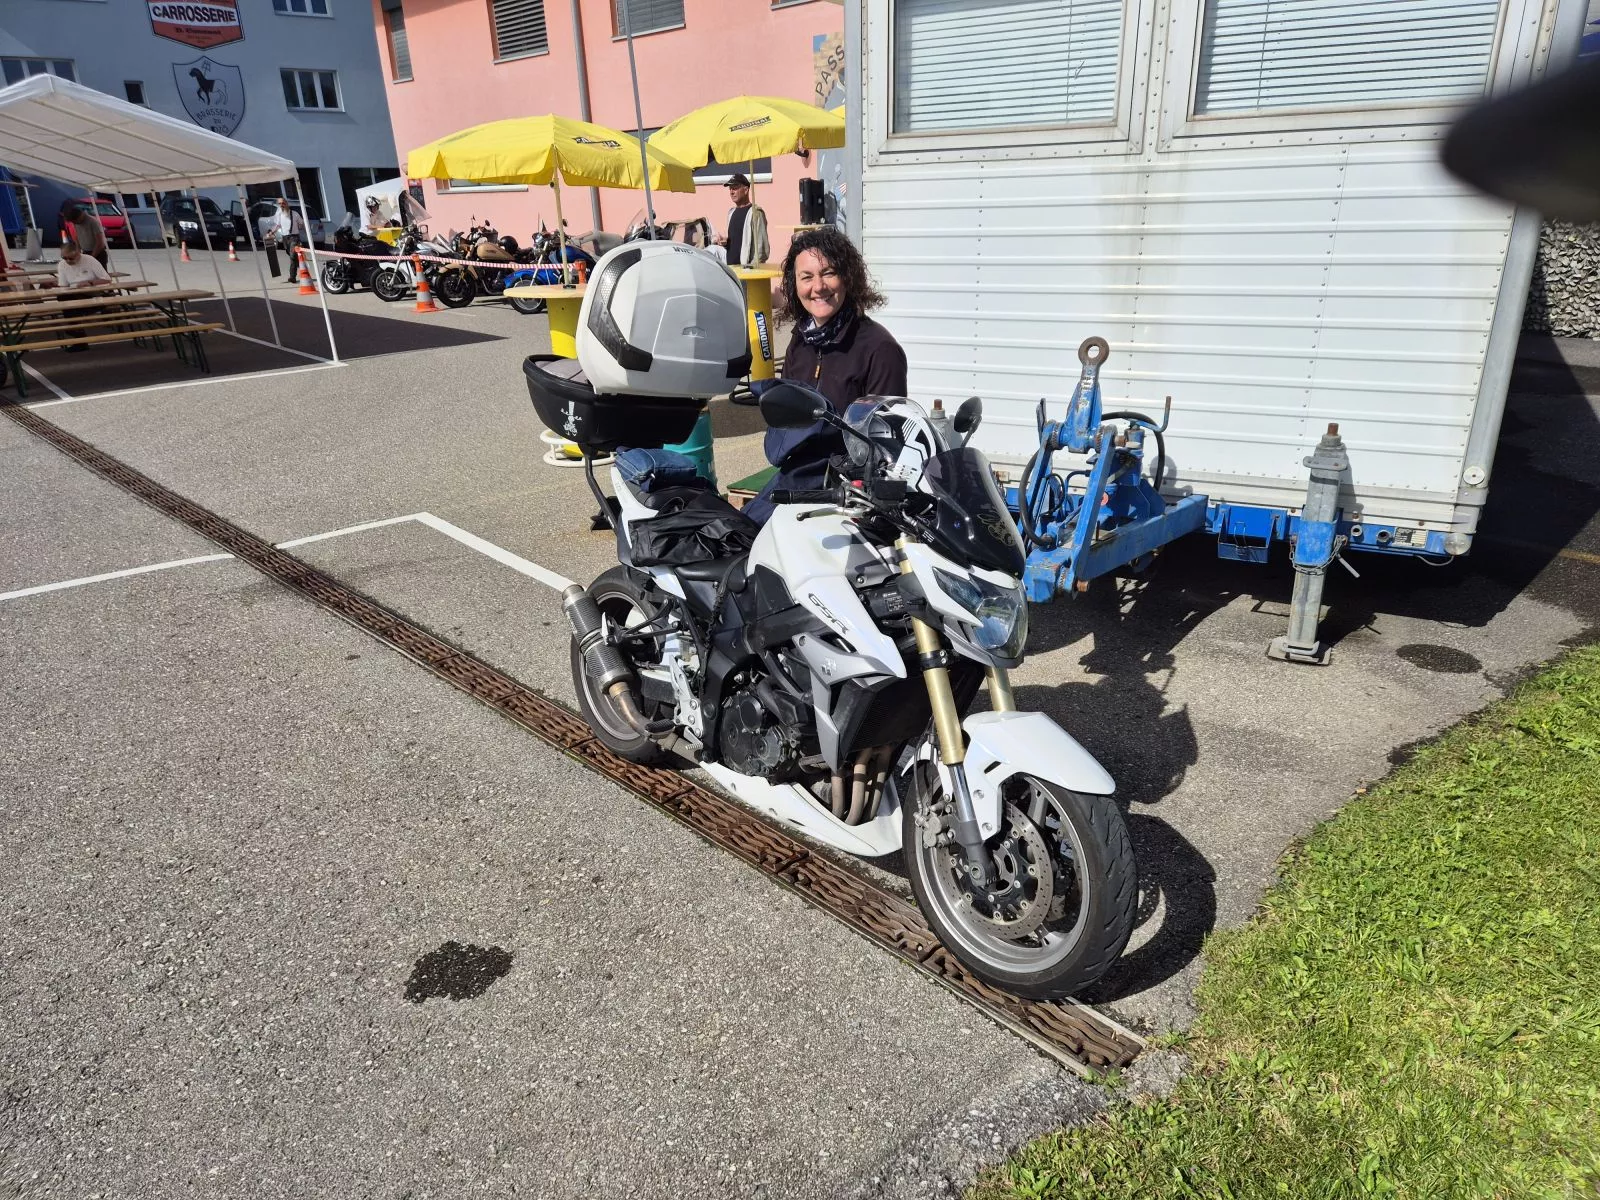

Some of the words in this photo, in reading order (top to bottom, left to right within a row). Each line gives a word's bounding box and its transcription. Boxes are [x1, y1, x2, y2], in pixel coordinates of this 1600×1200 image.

[152, 5, 236, 22] CARROSSERIE
[757, 314, 771, 358] CARDINAL
[808, 593, 848, 635] GSR
